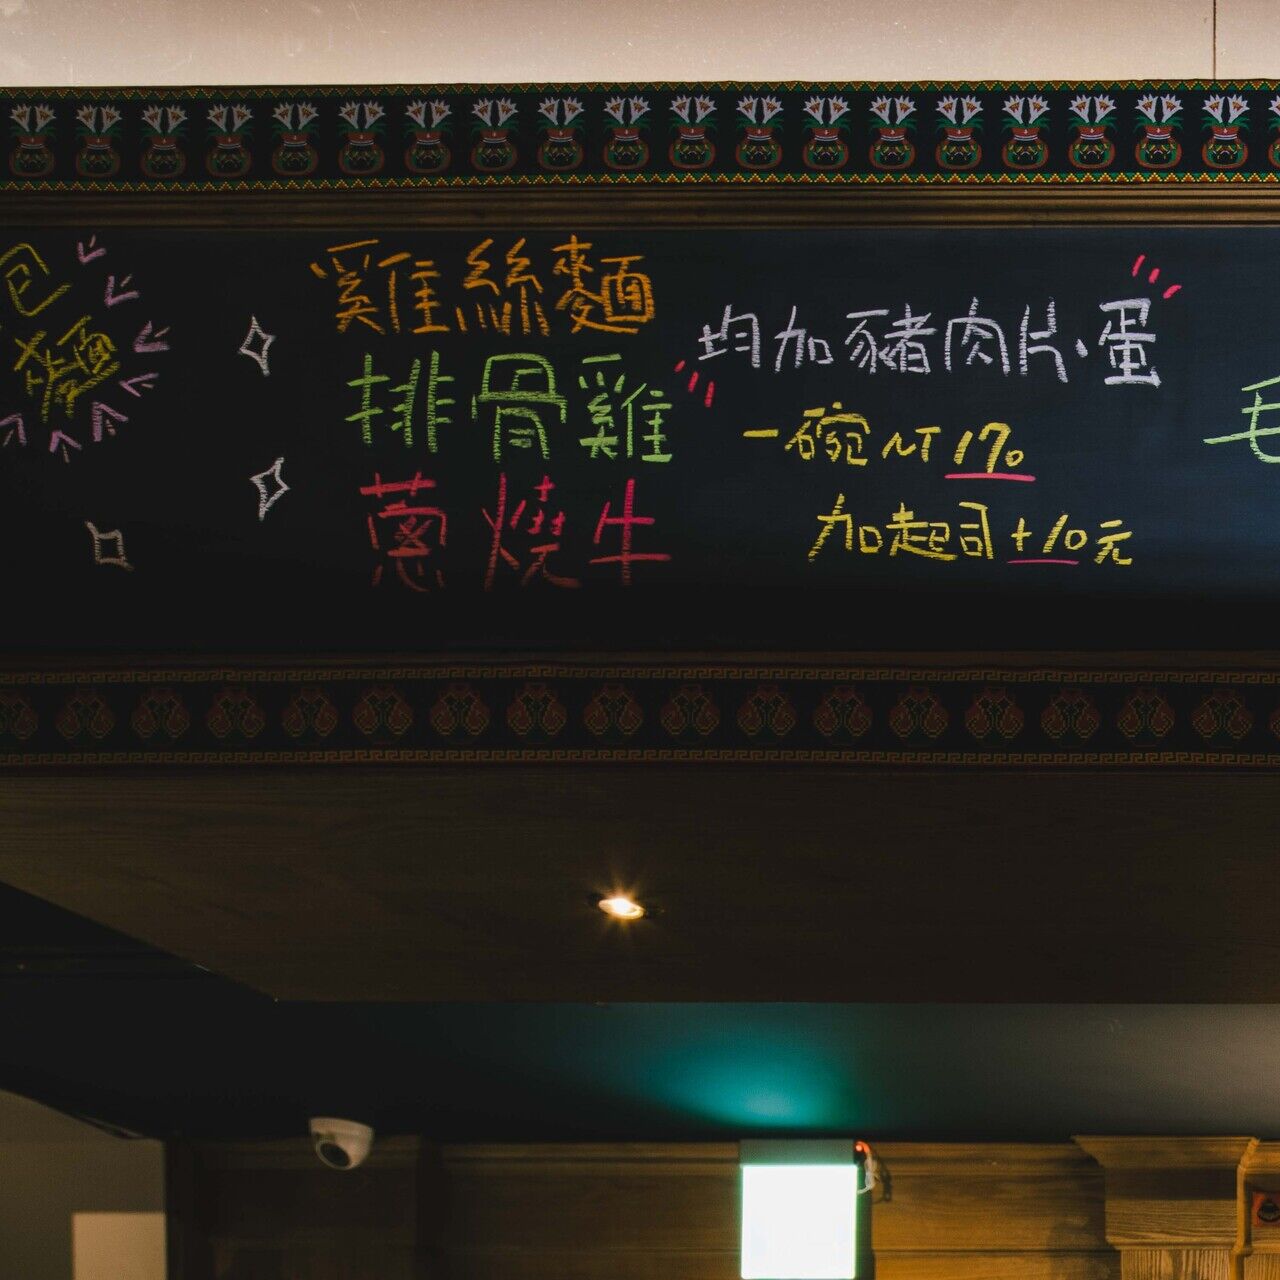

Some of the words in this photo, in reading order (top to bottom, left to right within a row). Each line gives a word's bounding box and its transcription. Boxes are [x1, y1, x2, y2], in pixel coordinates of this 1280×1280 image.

[311, 235, 654, 335] 雞絲麵
[346, 351, 672, 462] 排骨雞
